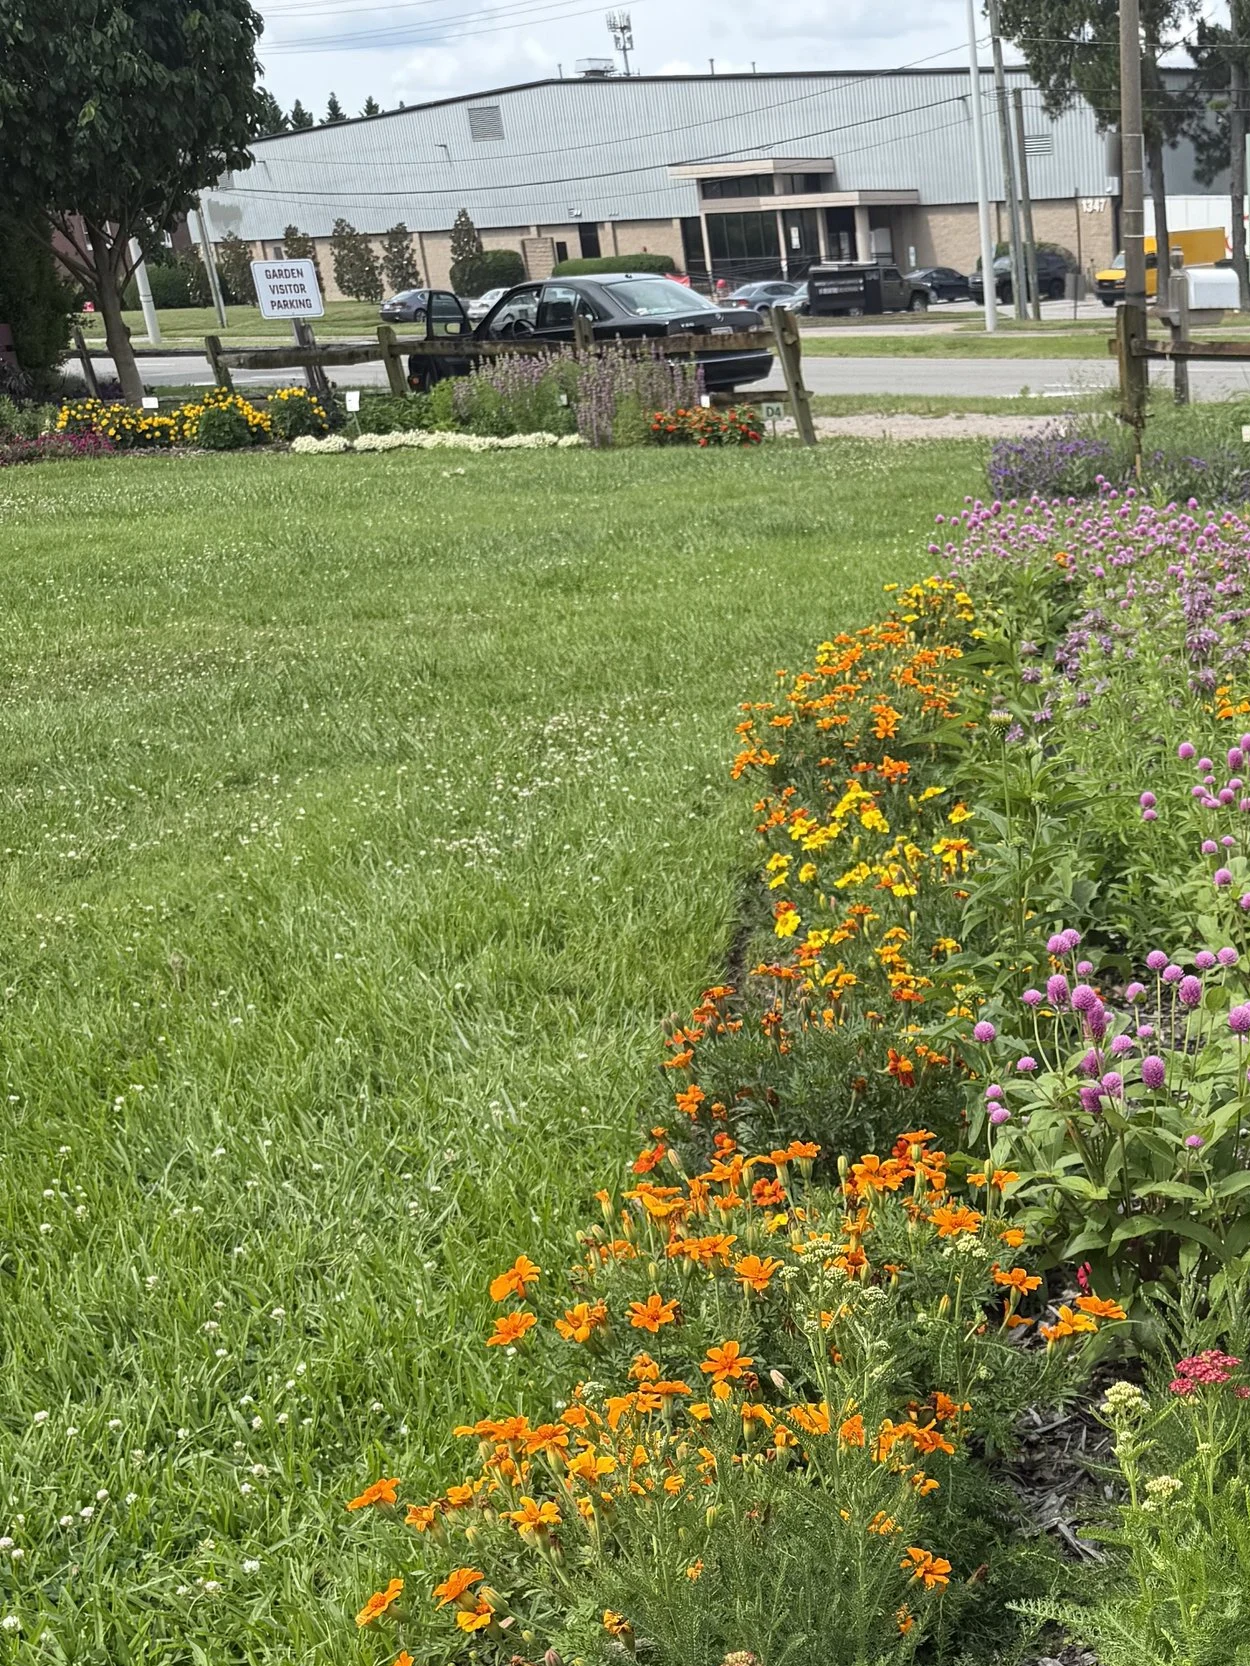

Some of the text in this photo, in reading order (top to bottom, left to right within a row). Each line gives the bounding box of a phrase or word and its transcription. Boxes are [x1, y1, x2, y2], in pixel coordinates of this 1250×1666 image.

[1081, 199, 1107, 213] 1347
[265, 268, 304, 279] GARDEN
[269, 283, 307, 295] VISITOR
[270, 298, 312, 310] PARKING
[766, 406, 781, 418] D4
